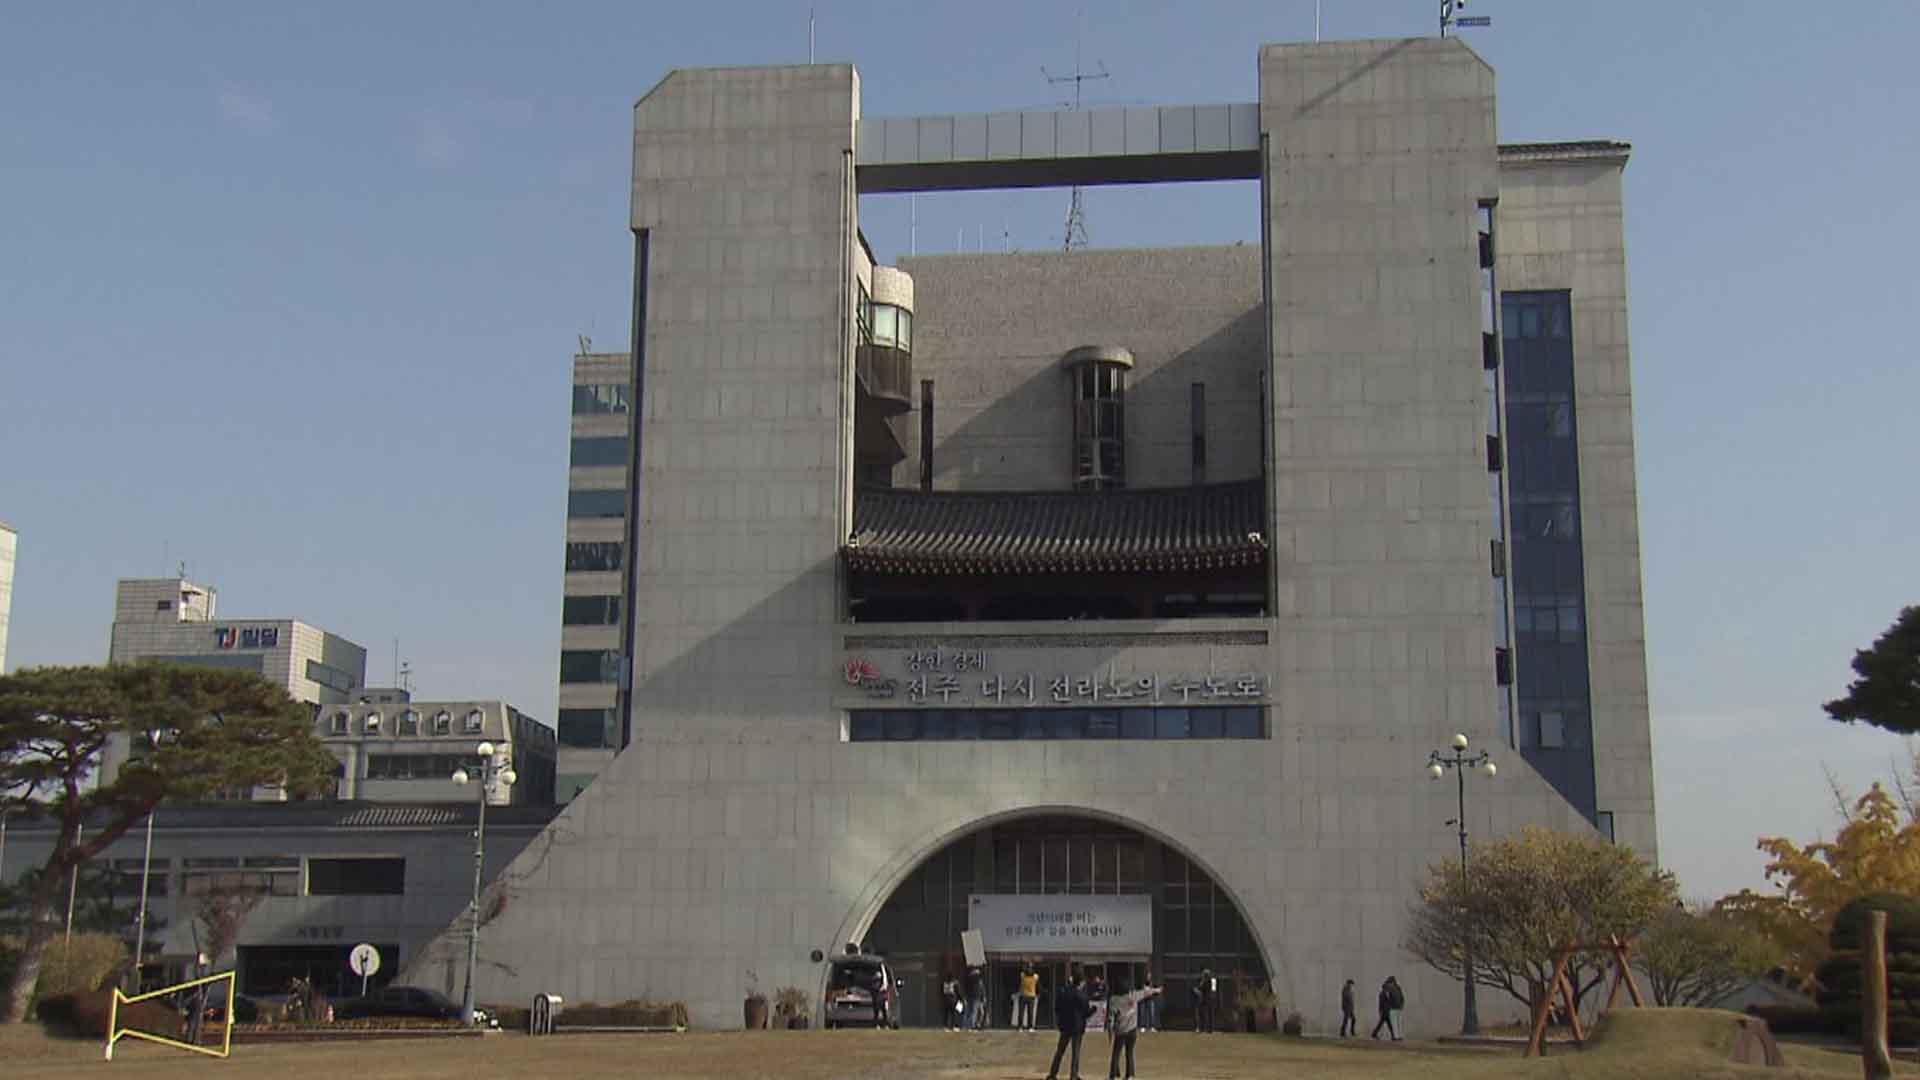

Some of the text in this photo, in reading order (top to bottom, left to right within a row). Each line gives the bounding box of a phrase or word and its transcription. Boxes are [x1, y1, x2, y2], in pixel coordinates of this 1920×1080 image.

[212, 626, 279, 648] TJ 빌딩
[907, 647, 987, 672] 강한 경제
[982, 673, 1037, 706] 다시
